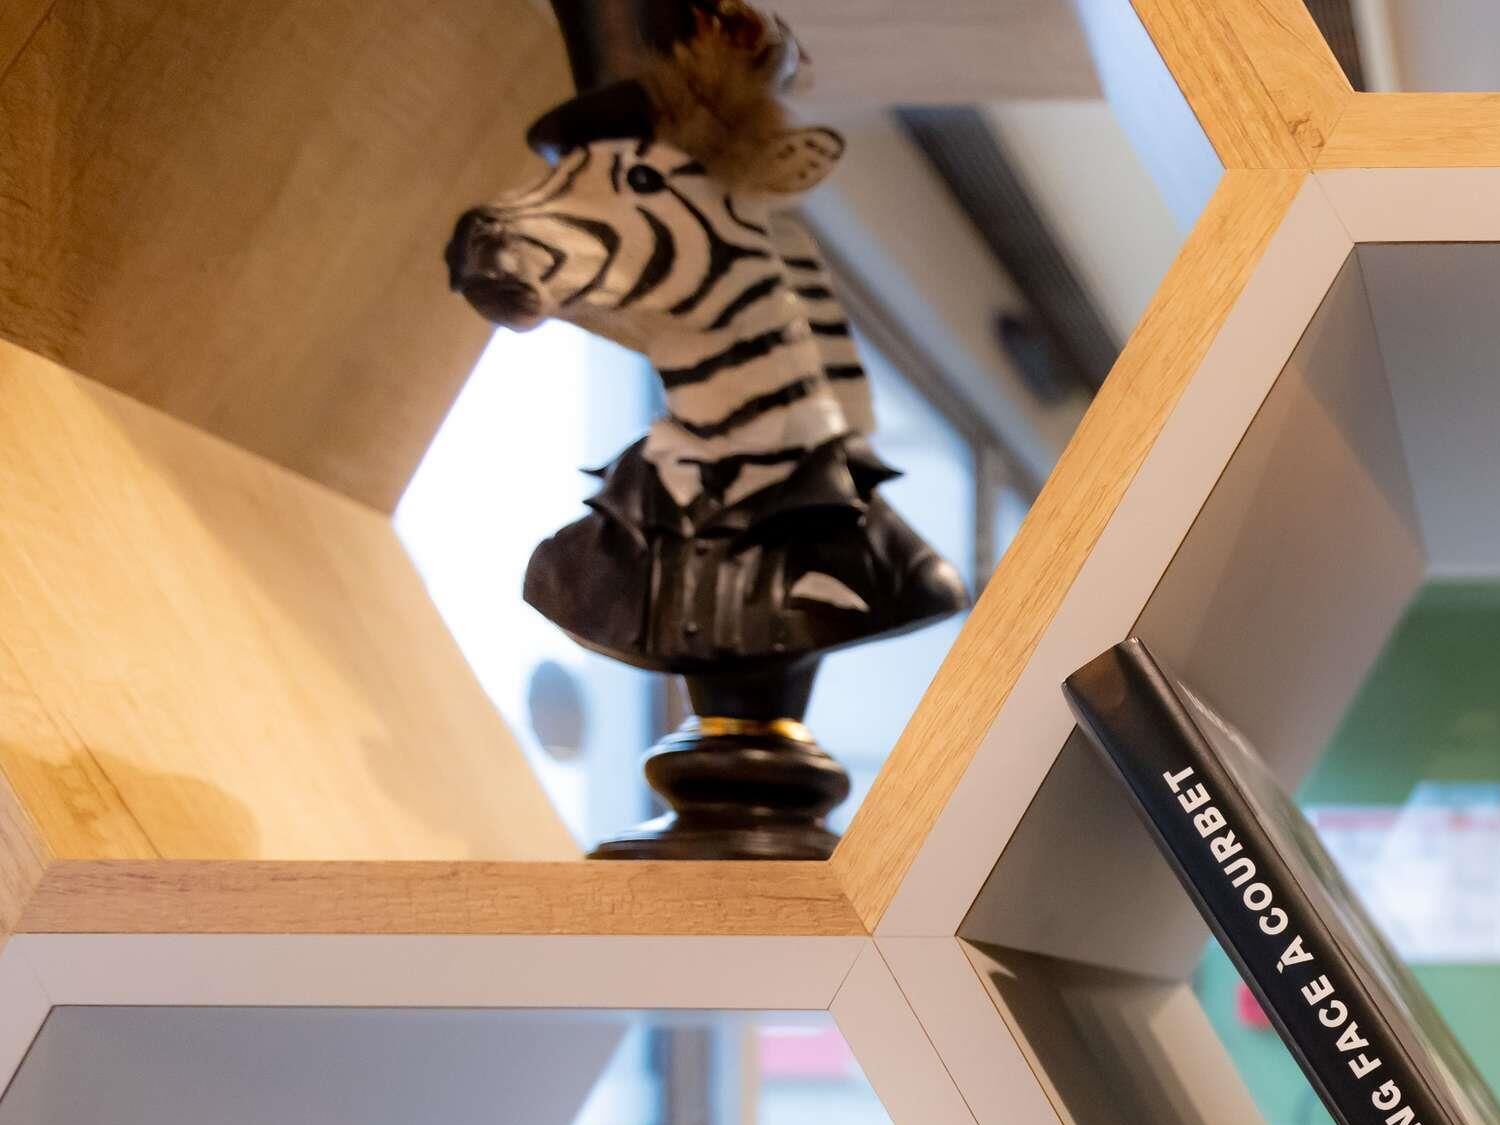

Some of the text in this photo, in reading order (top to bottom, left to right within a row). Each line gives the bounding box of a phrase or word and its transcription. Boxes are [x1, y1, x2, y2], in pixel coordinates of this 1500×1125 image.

[1162, 768, 1292, 937] COURBET
[1276, 936, 1315, 974] À
[1306, 975, 1384, 1080] FACE
